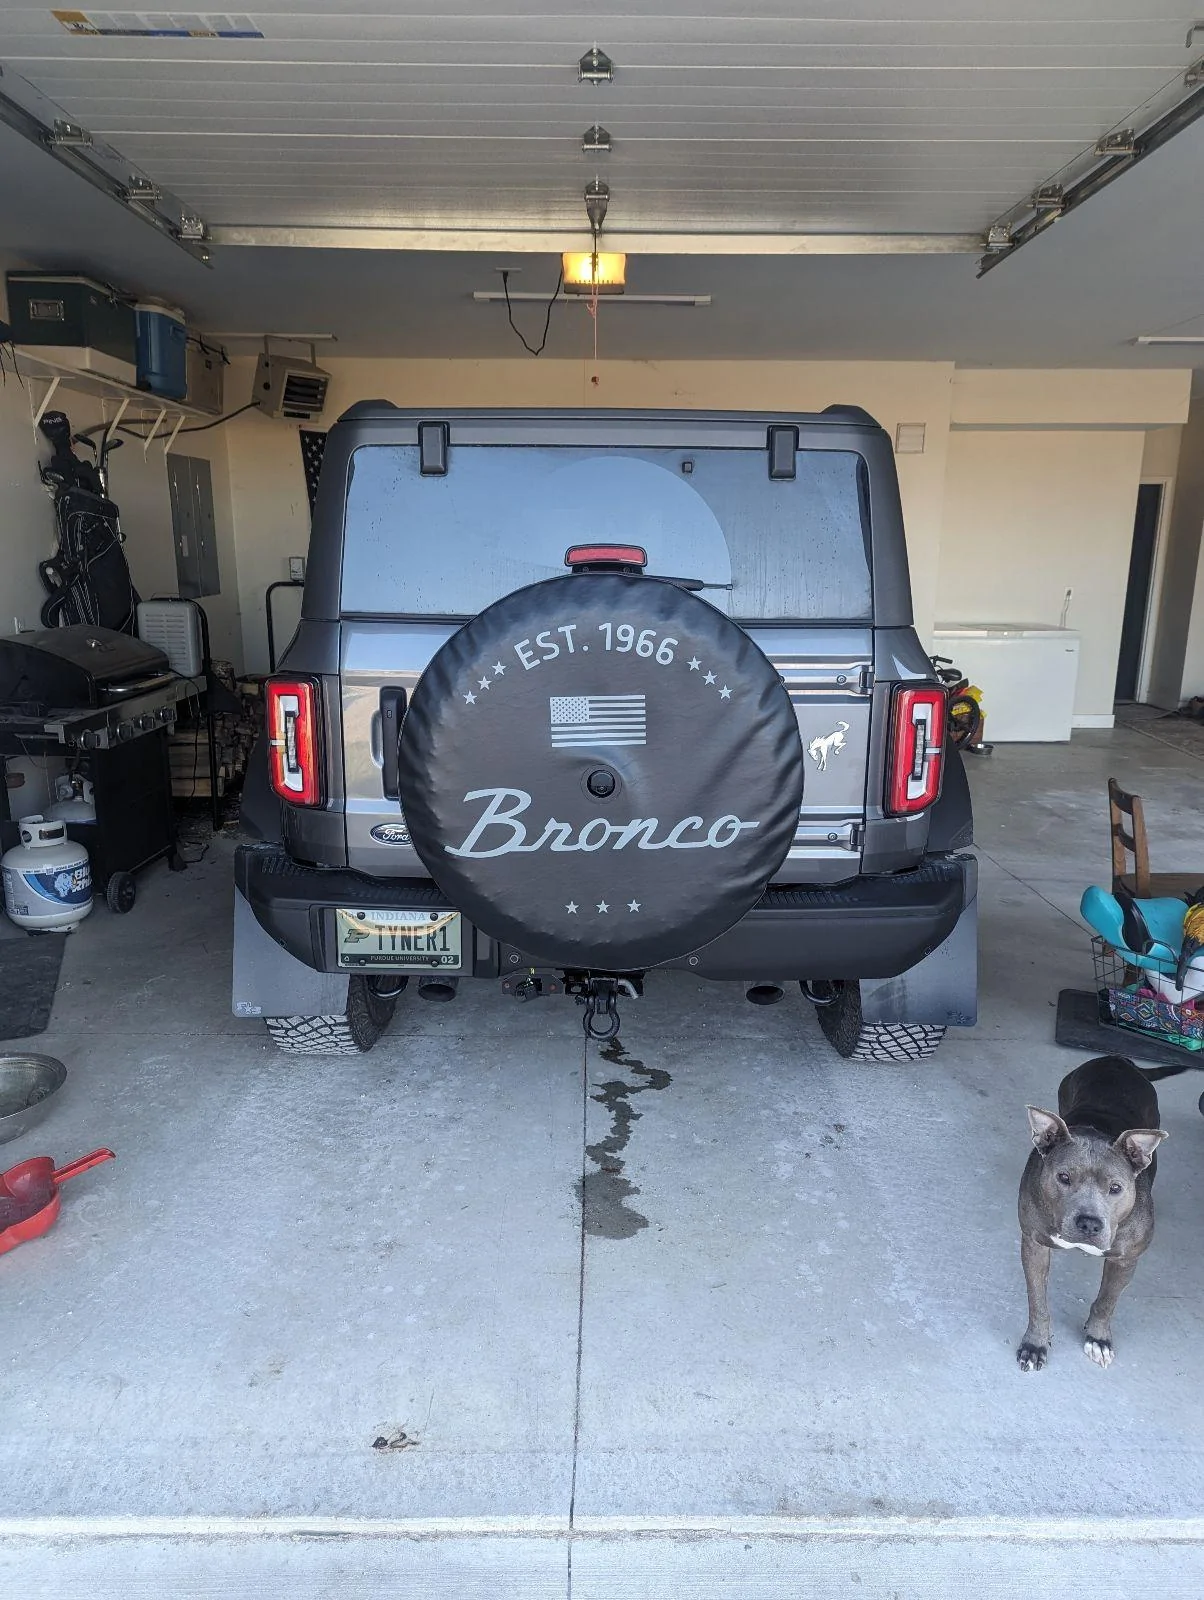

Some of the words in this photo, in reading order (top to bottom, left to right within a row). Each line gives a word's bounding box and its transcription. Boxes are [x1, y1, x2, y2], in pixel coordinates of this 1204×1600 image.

[514, 624, 589, 671] EST.
[598, 622, 679, 666] 1966
[444, 787, 760, 859] Bronco
[371, 911, 426, 921] INDIANA
[375, 925, 451, 951] TYNER1
[441, 955, 454, 964] 02
